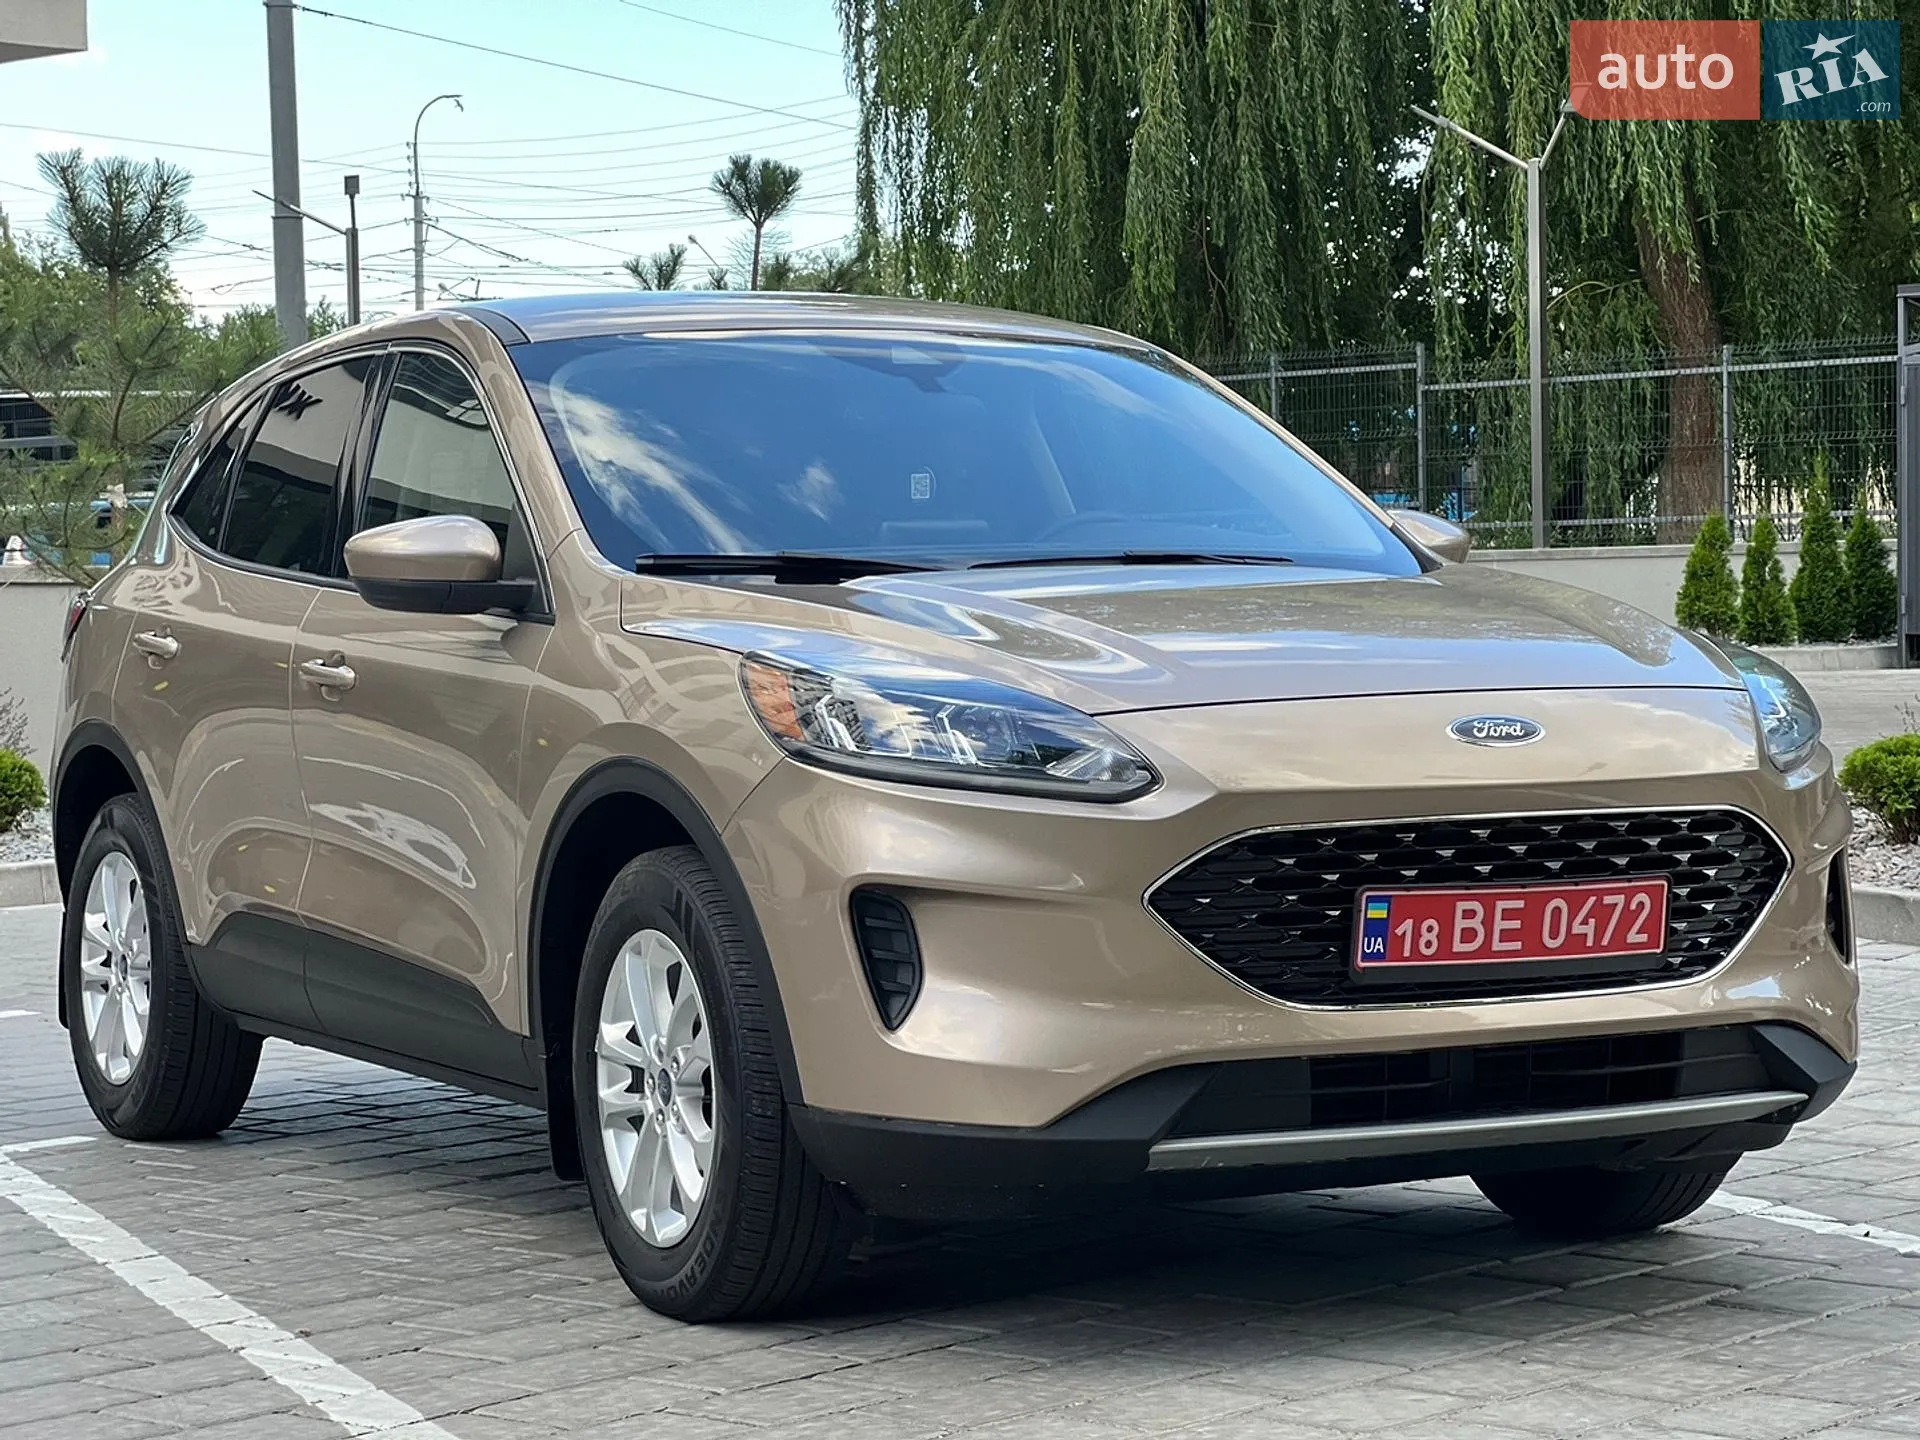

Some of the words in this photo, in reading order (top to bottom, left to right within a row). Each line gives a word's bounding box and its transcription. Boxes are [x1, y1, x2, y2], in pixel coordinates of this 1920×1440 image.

[1473, 719, 1524, 738] Ford
[1395, 918, 1440, 958] 18
[1452, 900, 1525, 953] BE
[1542, 892, 1651, 949] 0472
[1364, 937, 1384, 953] UA
